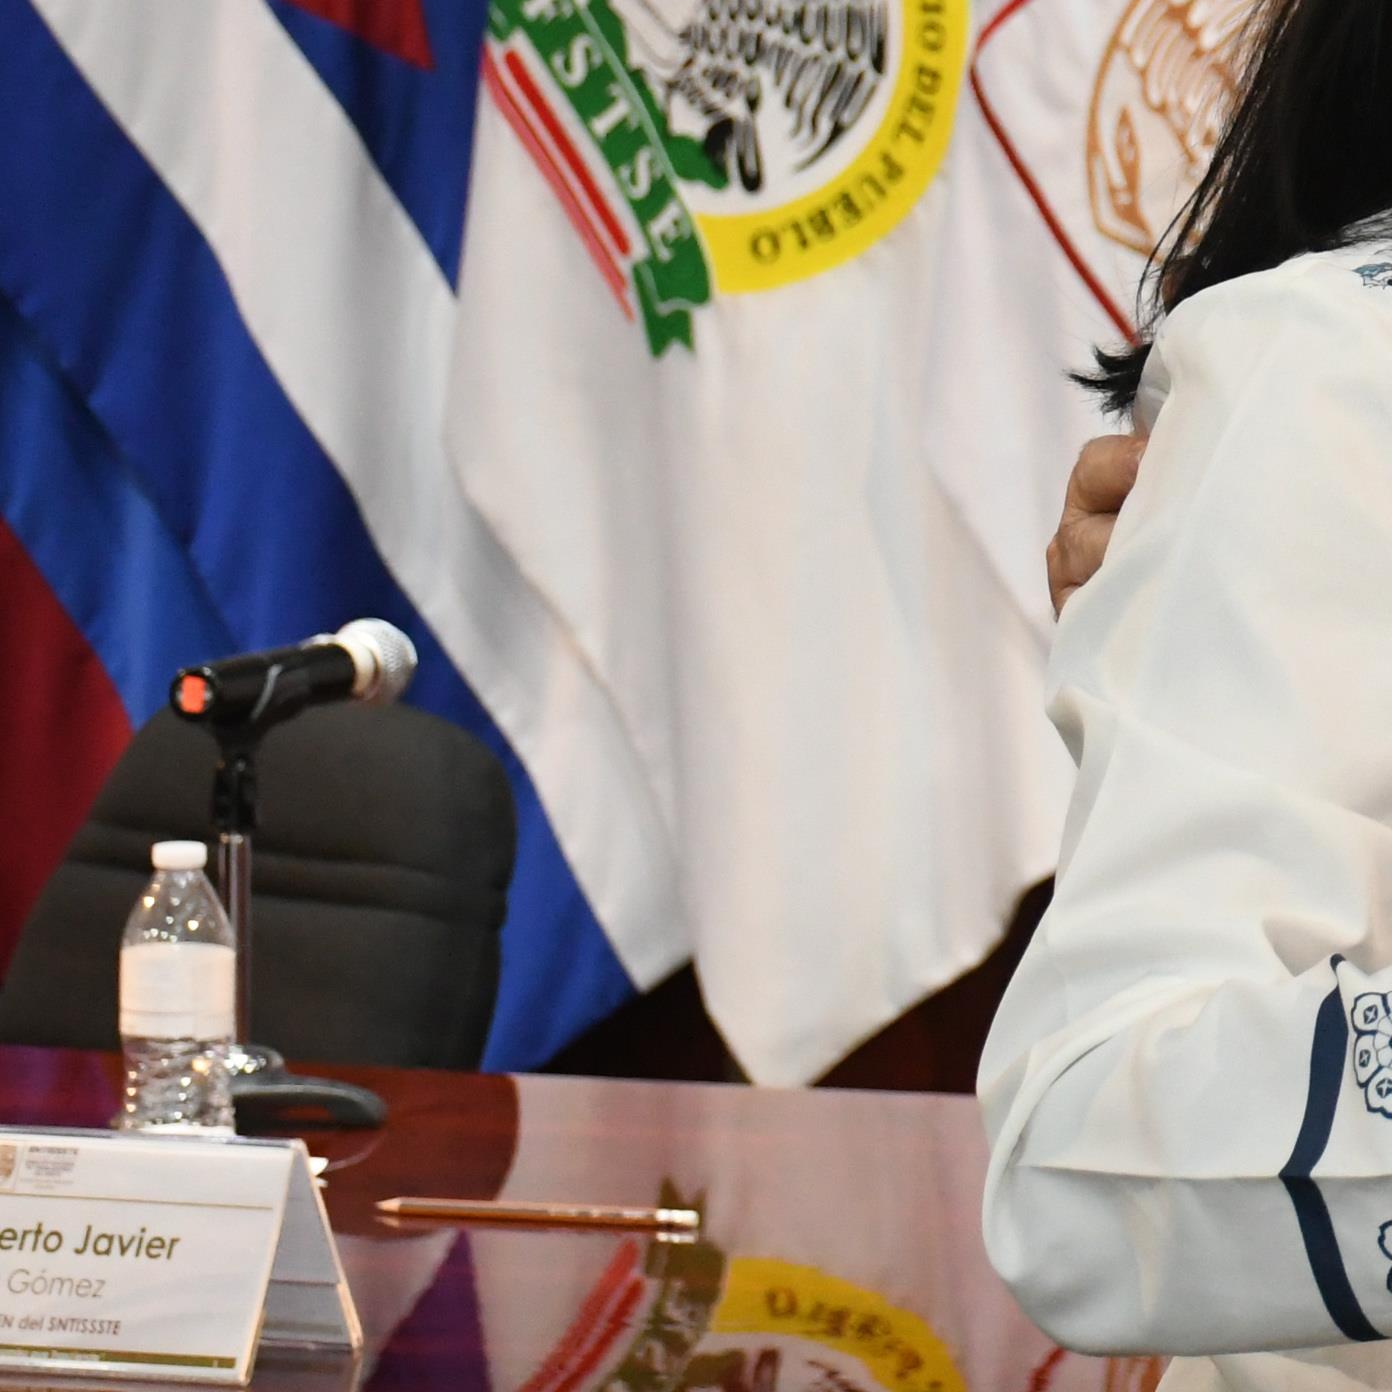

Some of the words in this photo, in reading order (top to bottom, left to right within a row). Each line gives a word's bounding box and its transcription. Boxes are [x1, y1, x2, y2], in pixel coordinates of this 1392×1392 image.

[893, 63, 943, 145] DEL
[749, 151, 904, 264] PUEBLO
[0, 1222, 63, 1253] erto
[74, 1224, 181, 1260] Javier
[7, 1267, 106, 1298] Gómez
[18, 1314, 44, 1331] del
[47, 1317, 122, 1336] SNTISSSTE
